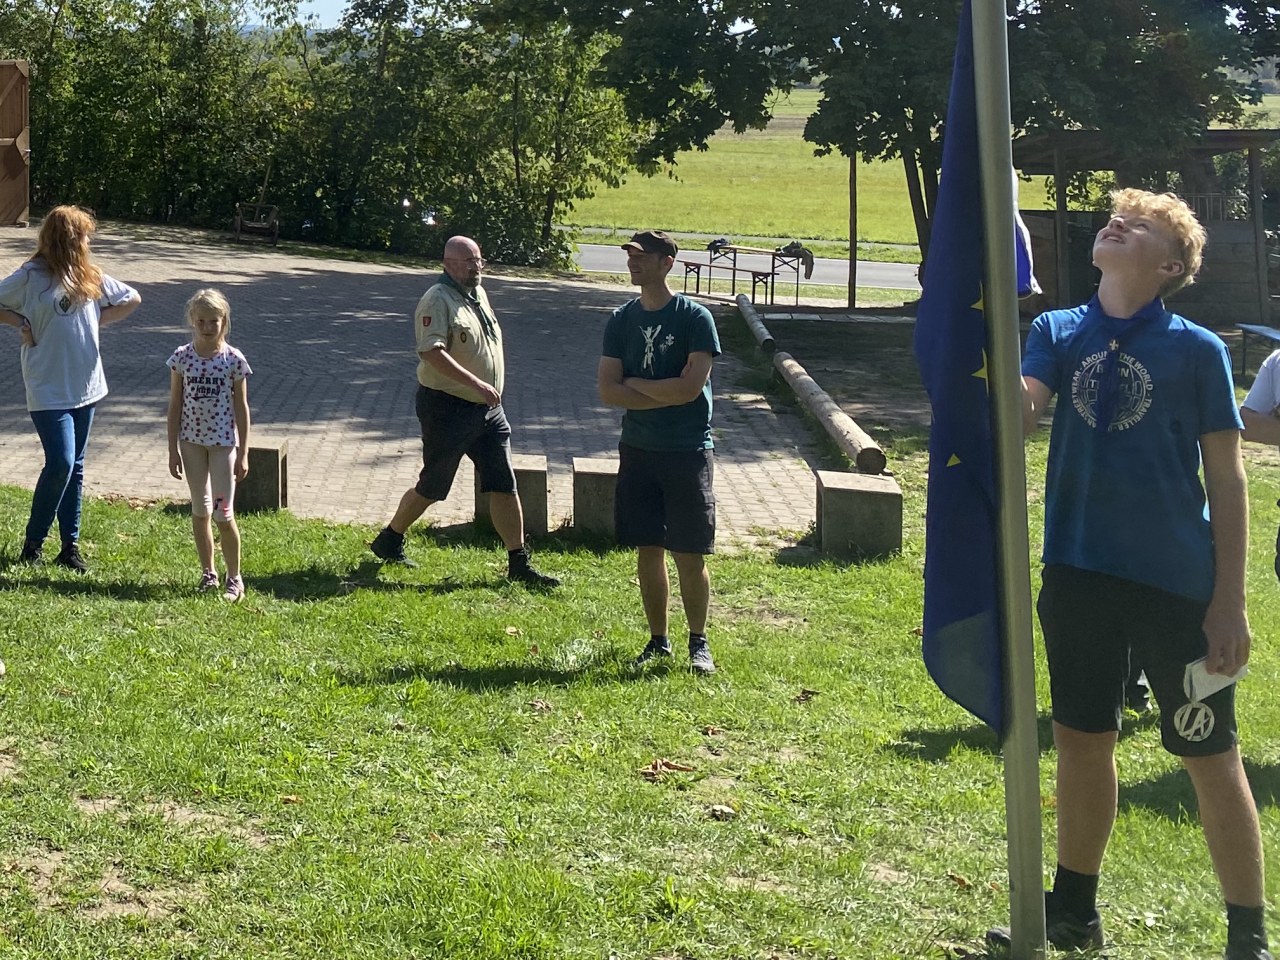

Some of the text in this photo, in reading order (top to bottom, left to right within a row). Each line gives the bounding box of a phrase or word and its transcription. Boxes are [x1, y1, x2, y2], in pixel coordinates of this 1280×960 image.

[1119, 352, 1136, 365] THE
[1134, 361, 1153, 390] WORLD
[1117, 398, 1153, 431] TRAVELLER
